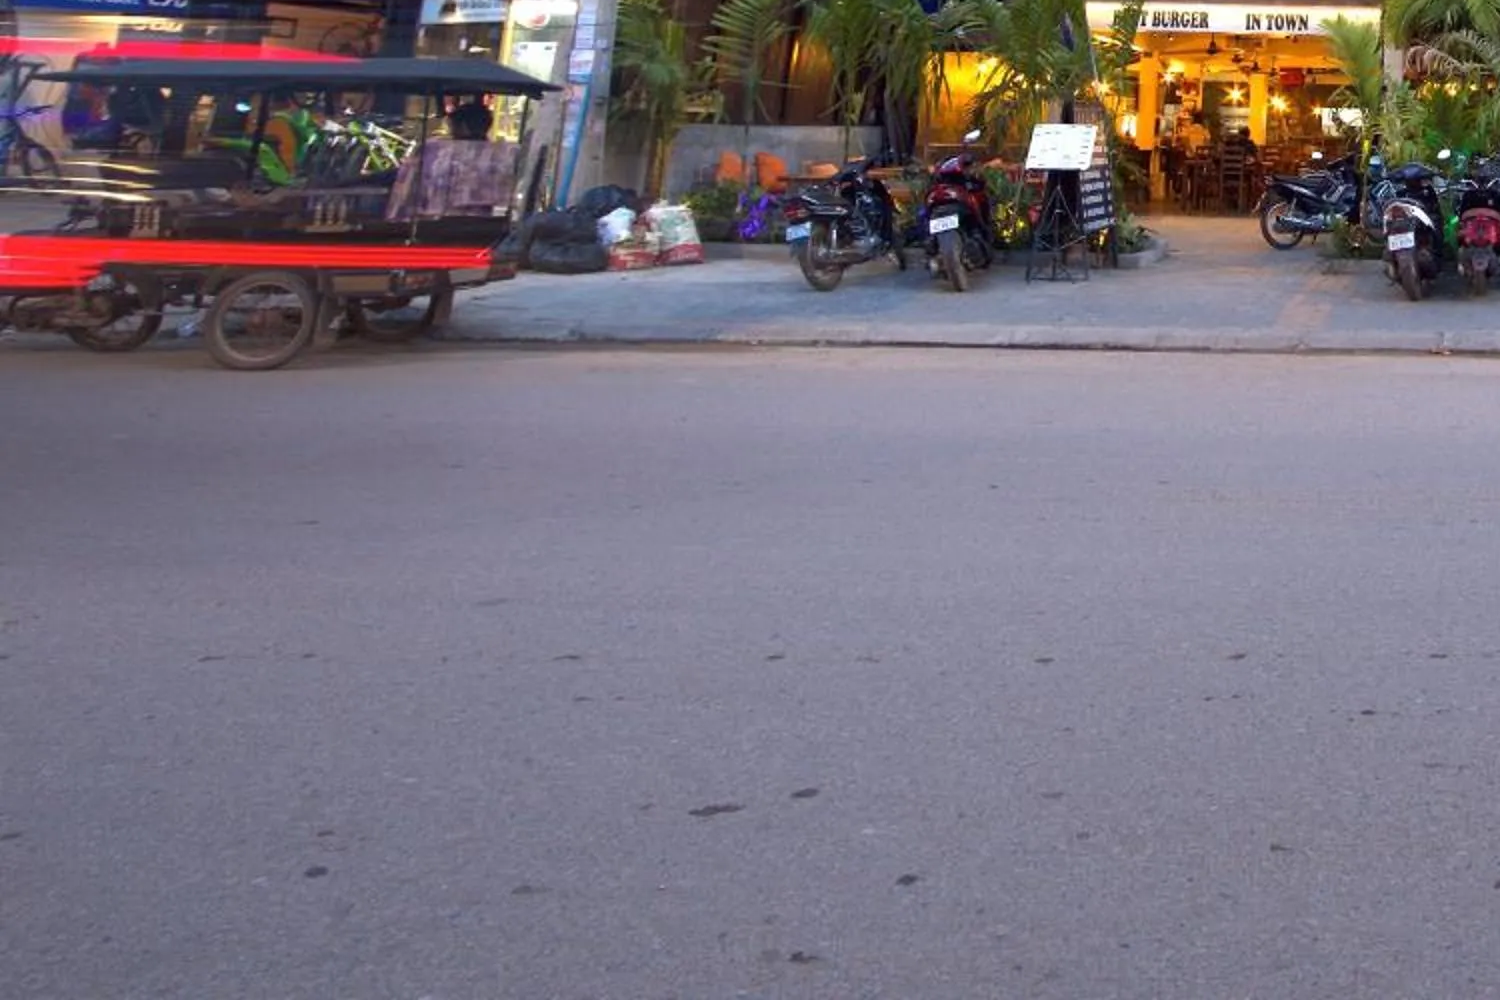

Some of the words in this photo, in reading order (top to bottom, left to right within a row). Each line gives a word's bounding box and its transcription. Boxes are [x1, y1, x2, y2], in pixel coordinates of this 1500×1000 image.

[1152, 11, 1210, 30] BURGER
[1245, 13, 1262, 30] IN
[1266, 14, 1309, 31] TOWN
